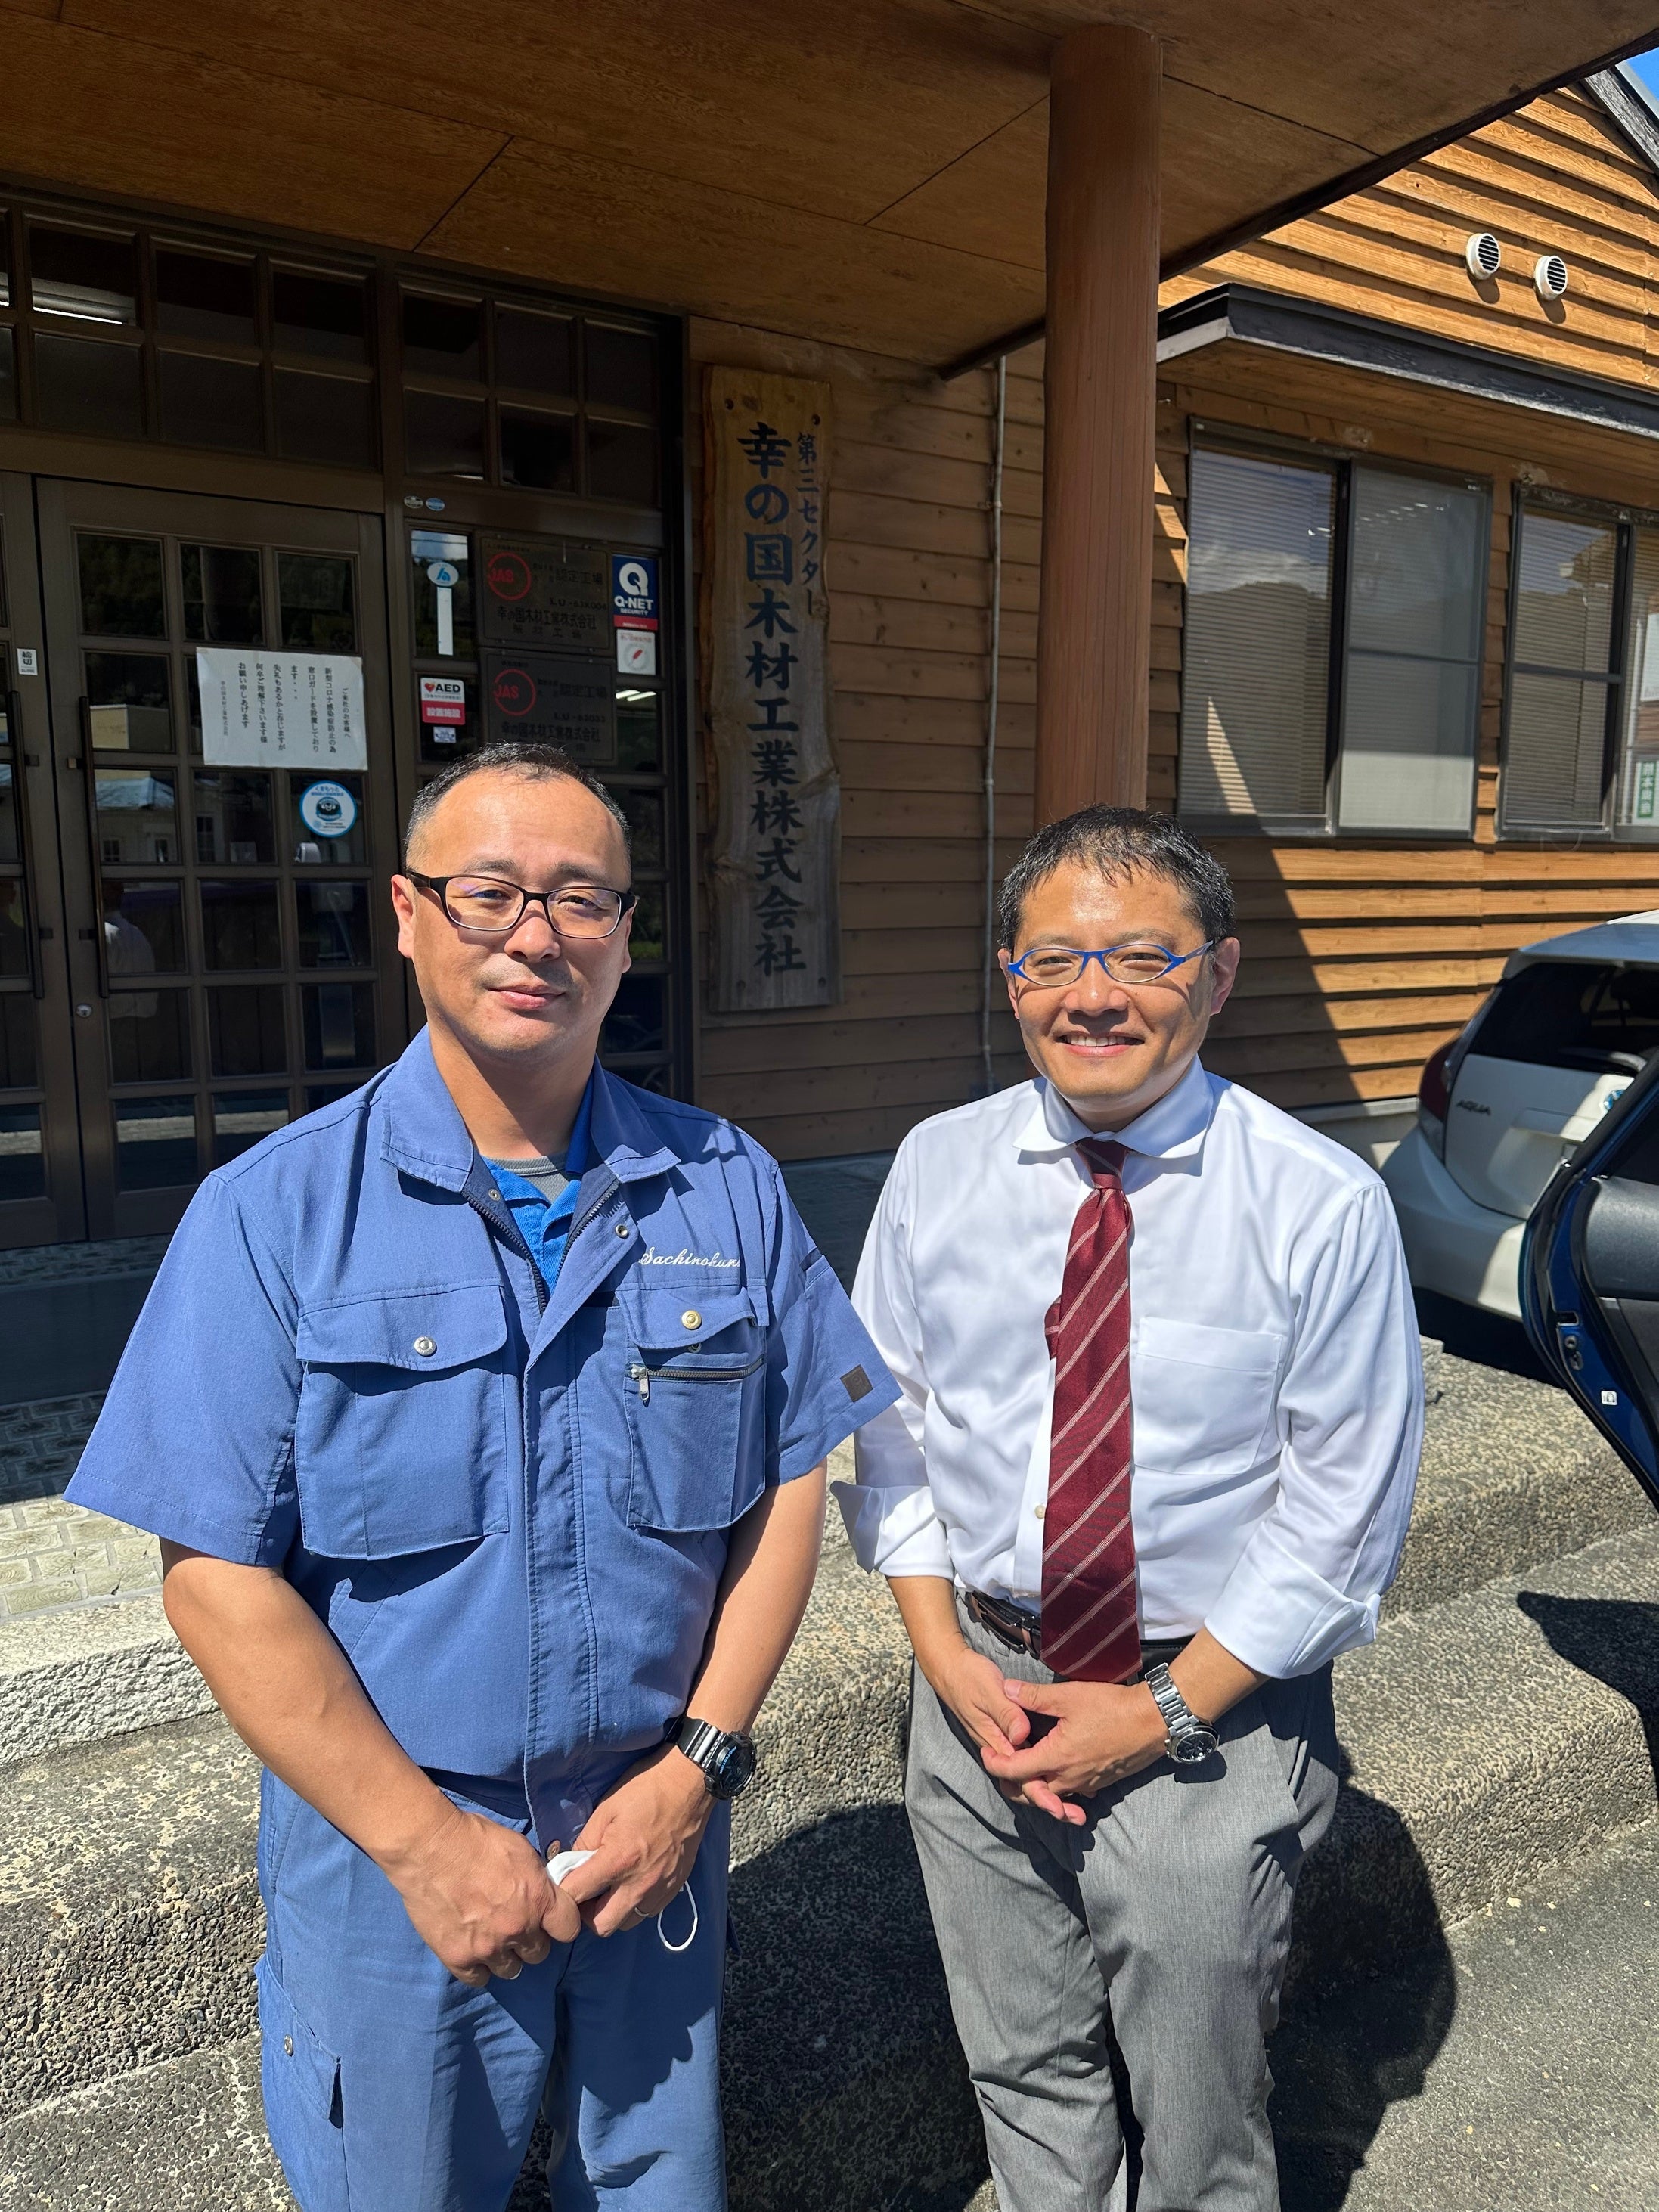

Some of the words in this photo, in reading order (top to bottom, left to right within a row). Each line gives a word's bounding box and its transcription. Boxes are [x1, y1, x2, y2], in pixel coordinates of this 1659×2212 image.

[796, 431, 820, 616] 第三セクター
[488, 568, 514, 583] JAS
[436, 683, 460, 693] AED
[494, 685, 519, 700] JAS
[736, 421, 806, 976] 幸の国木材工業株式会社
[1456, 1100, 1491, 1116] AQUA
